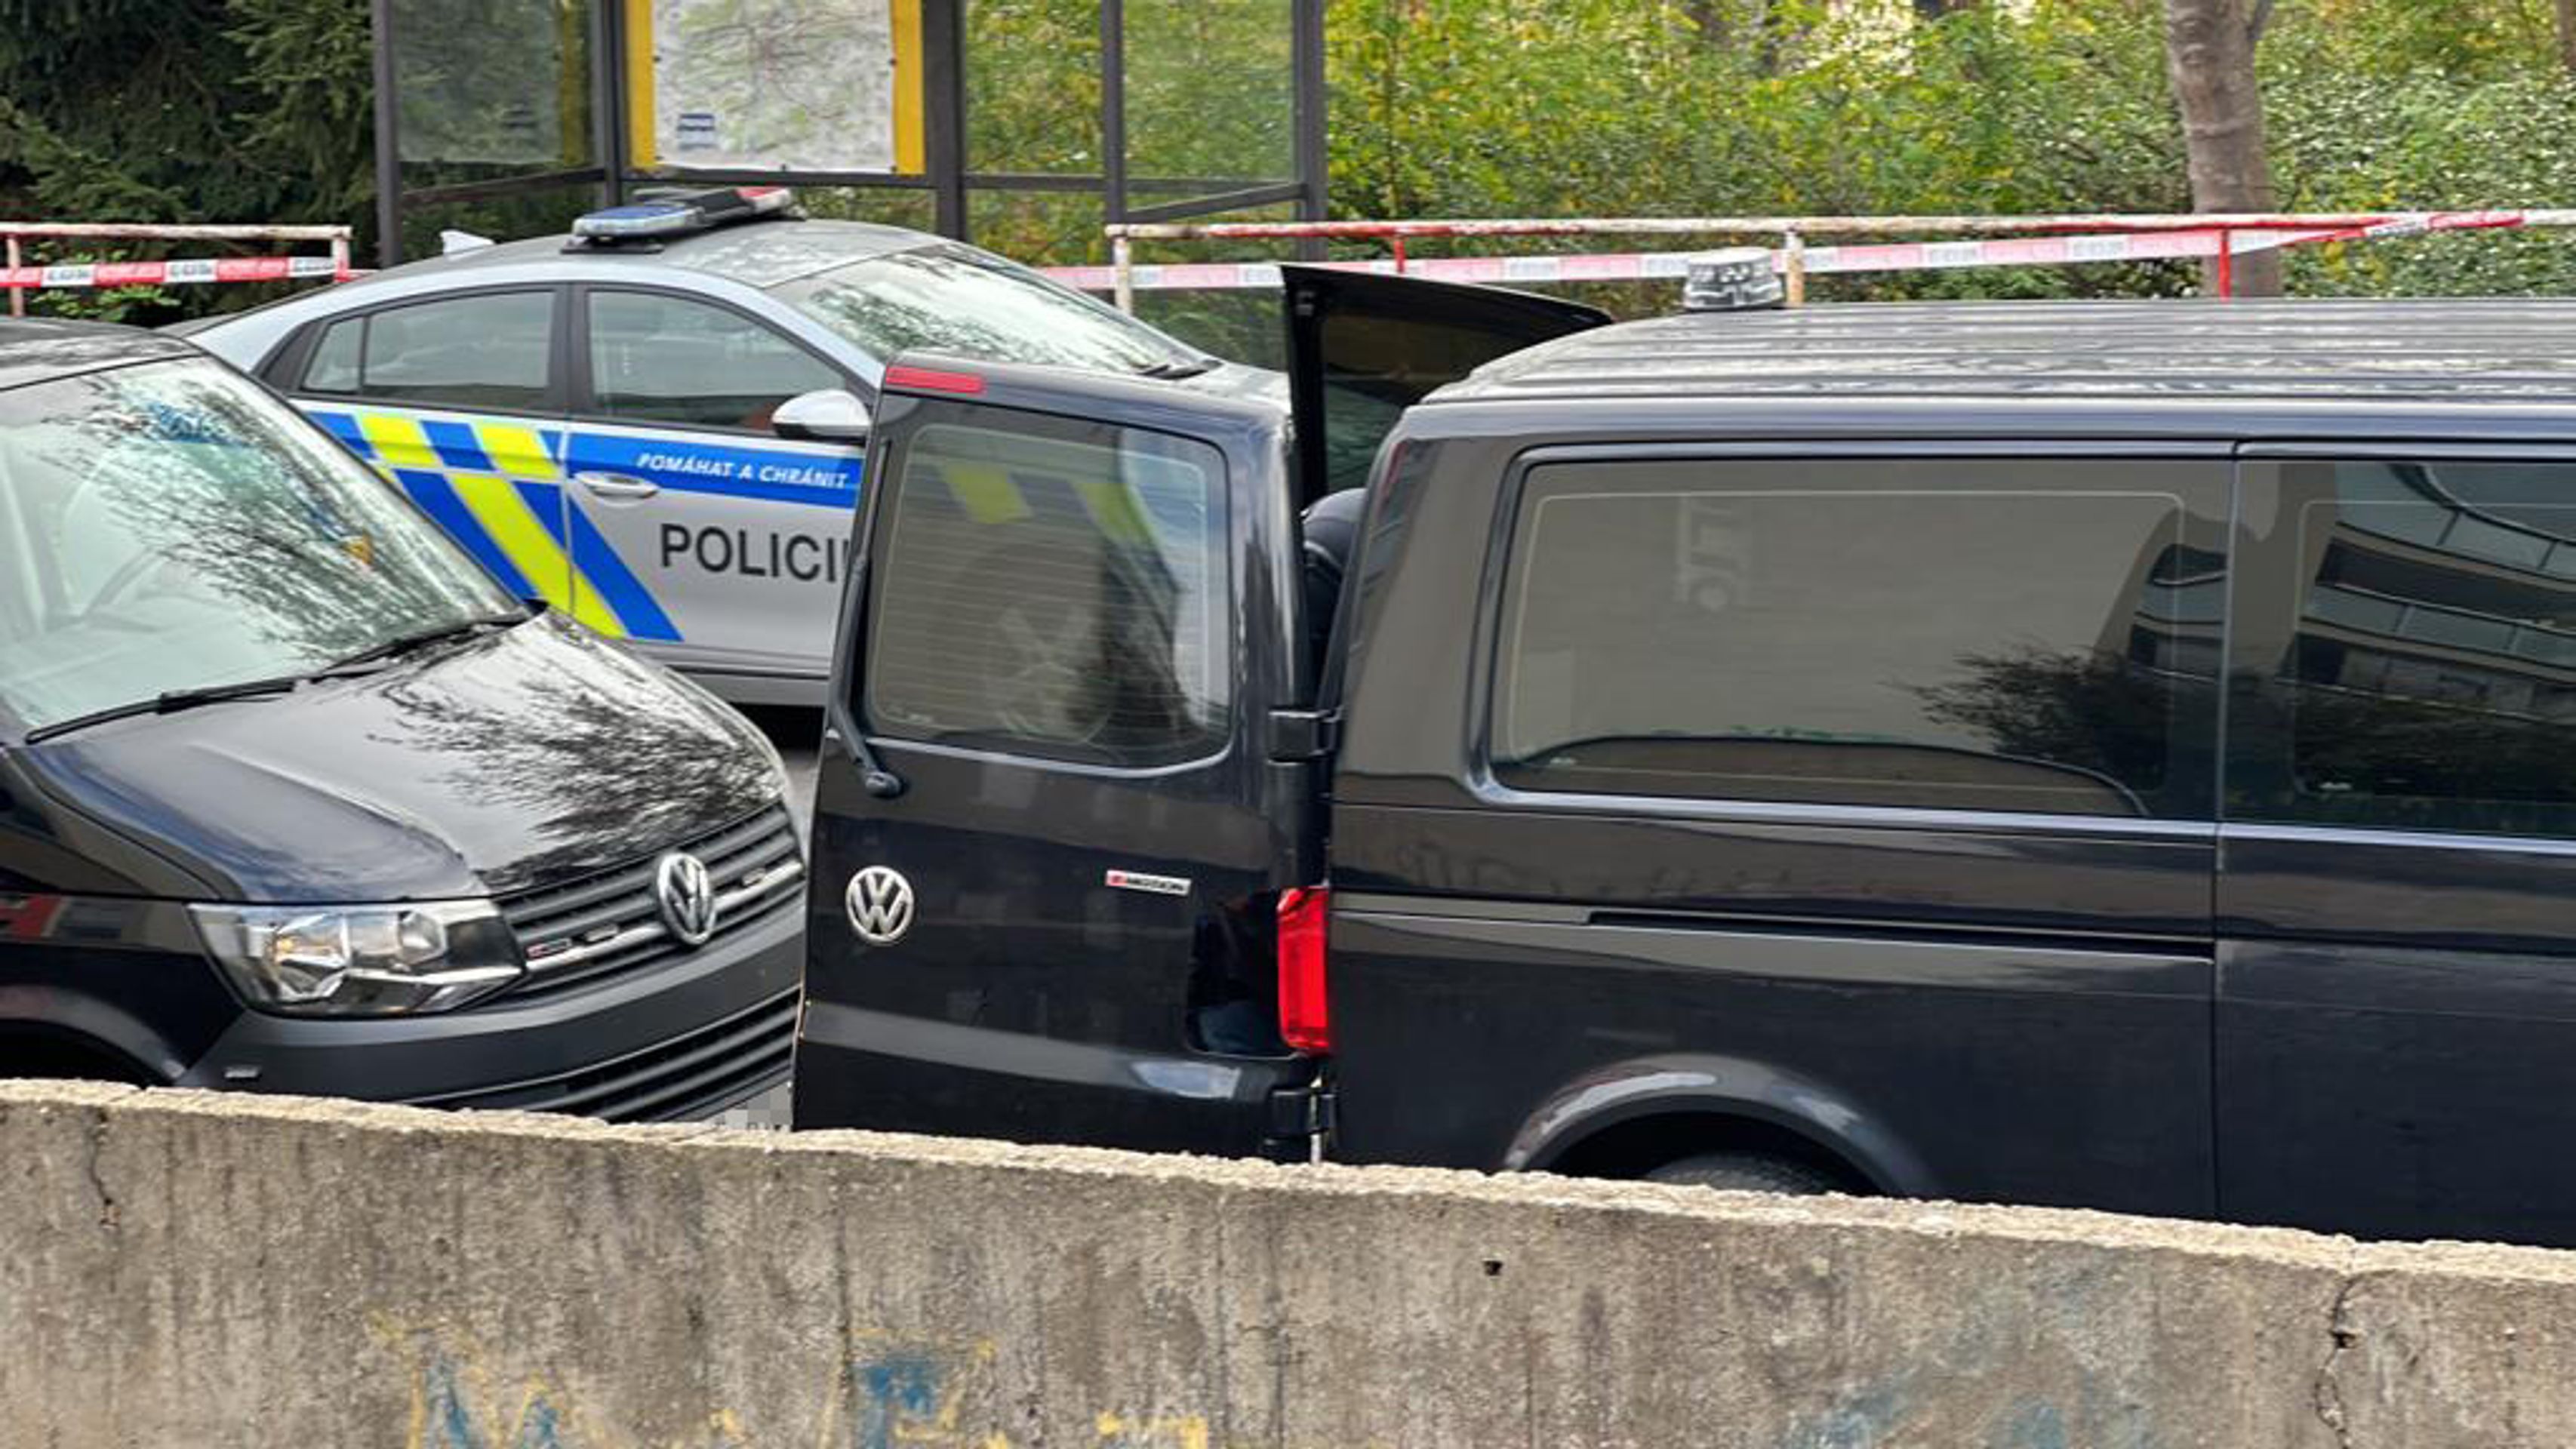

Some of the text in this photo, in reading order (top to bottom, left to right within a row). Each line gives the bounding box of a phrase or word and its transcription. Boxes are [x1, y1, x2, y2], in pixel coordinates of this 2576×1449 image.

[636, 453, 848, 489] POMÁHAT A CHRÁNIT
[660, 523, 849, 583] POLICI
